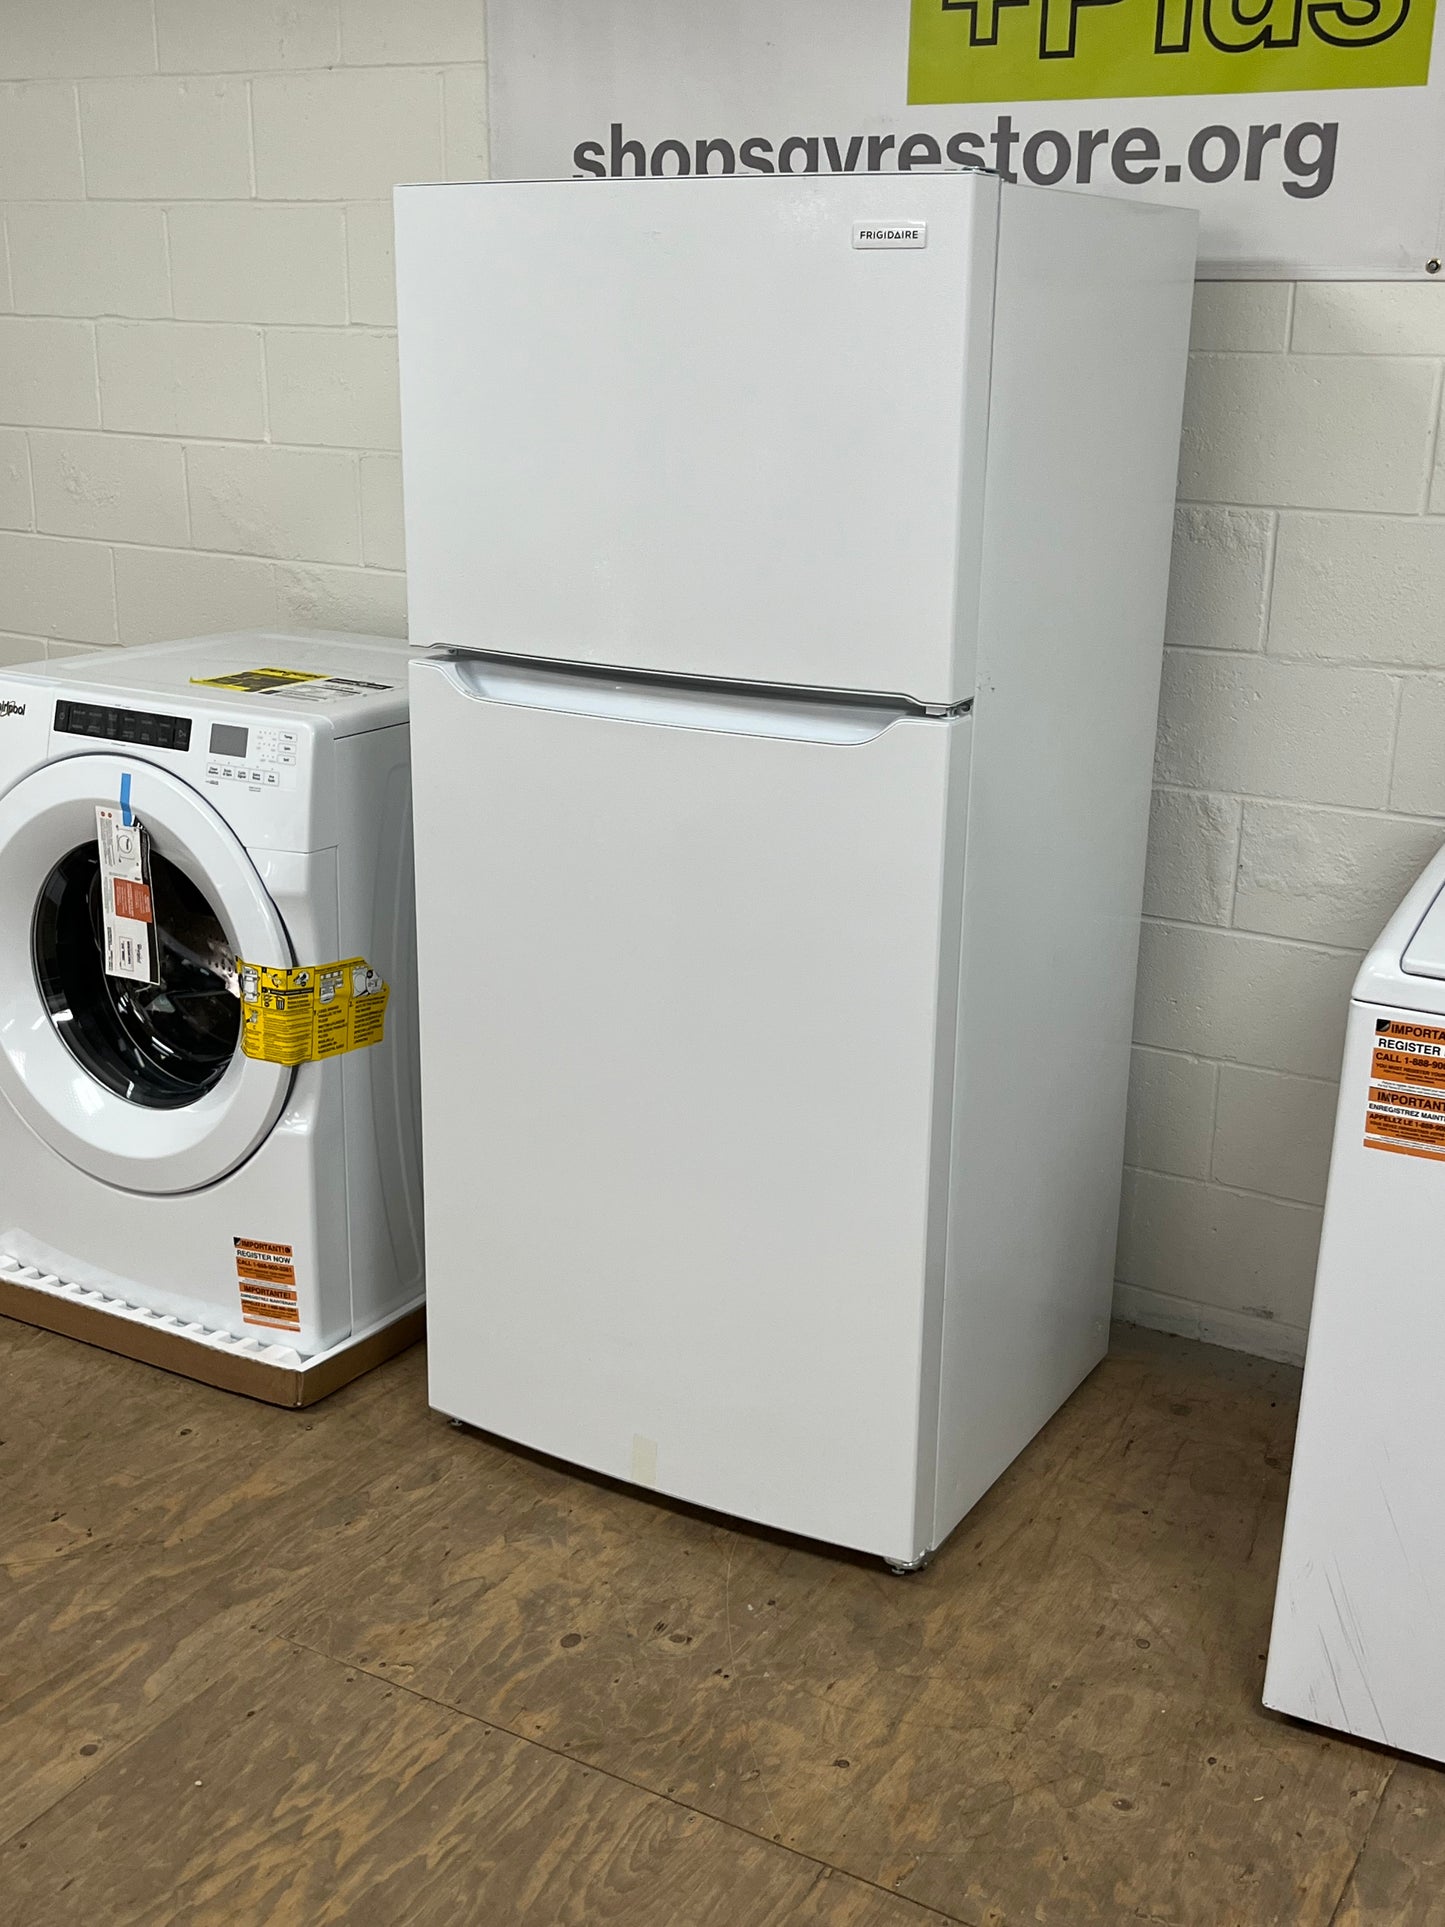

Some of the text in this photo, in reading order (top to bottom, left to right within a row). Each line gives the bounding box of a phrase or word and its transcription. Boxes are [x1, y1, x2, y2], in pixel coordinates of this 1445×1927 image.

[860, 230, 919, 240] FRIGIDAIRE
[1378, 1037, 1441, 1057] REGISTER
[1376, 1052, 1402, 1064] CALL
[1369, 1102, 1420, 1118] ENREGISTREZ
[237, 1249, 291, 1264] REGISTER NOW
